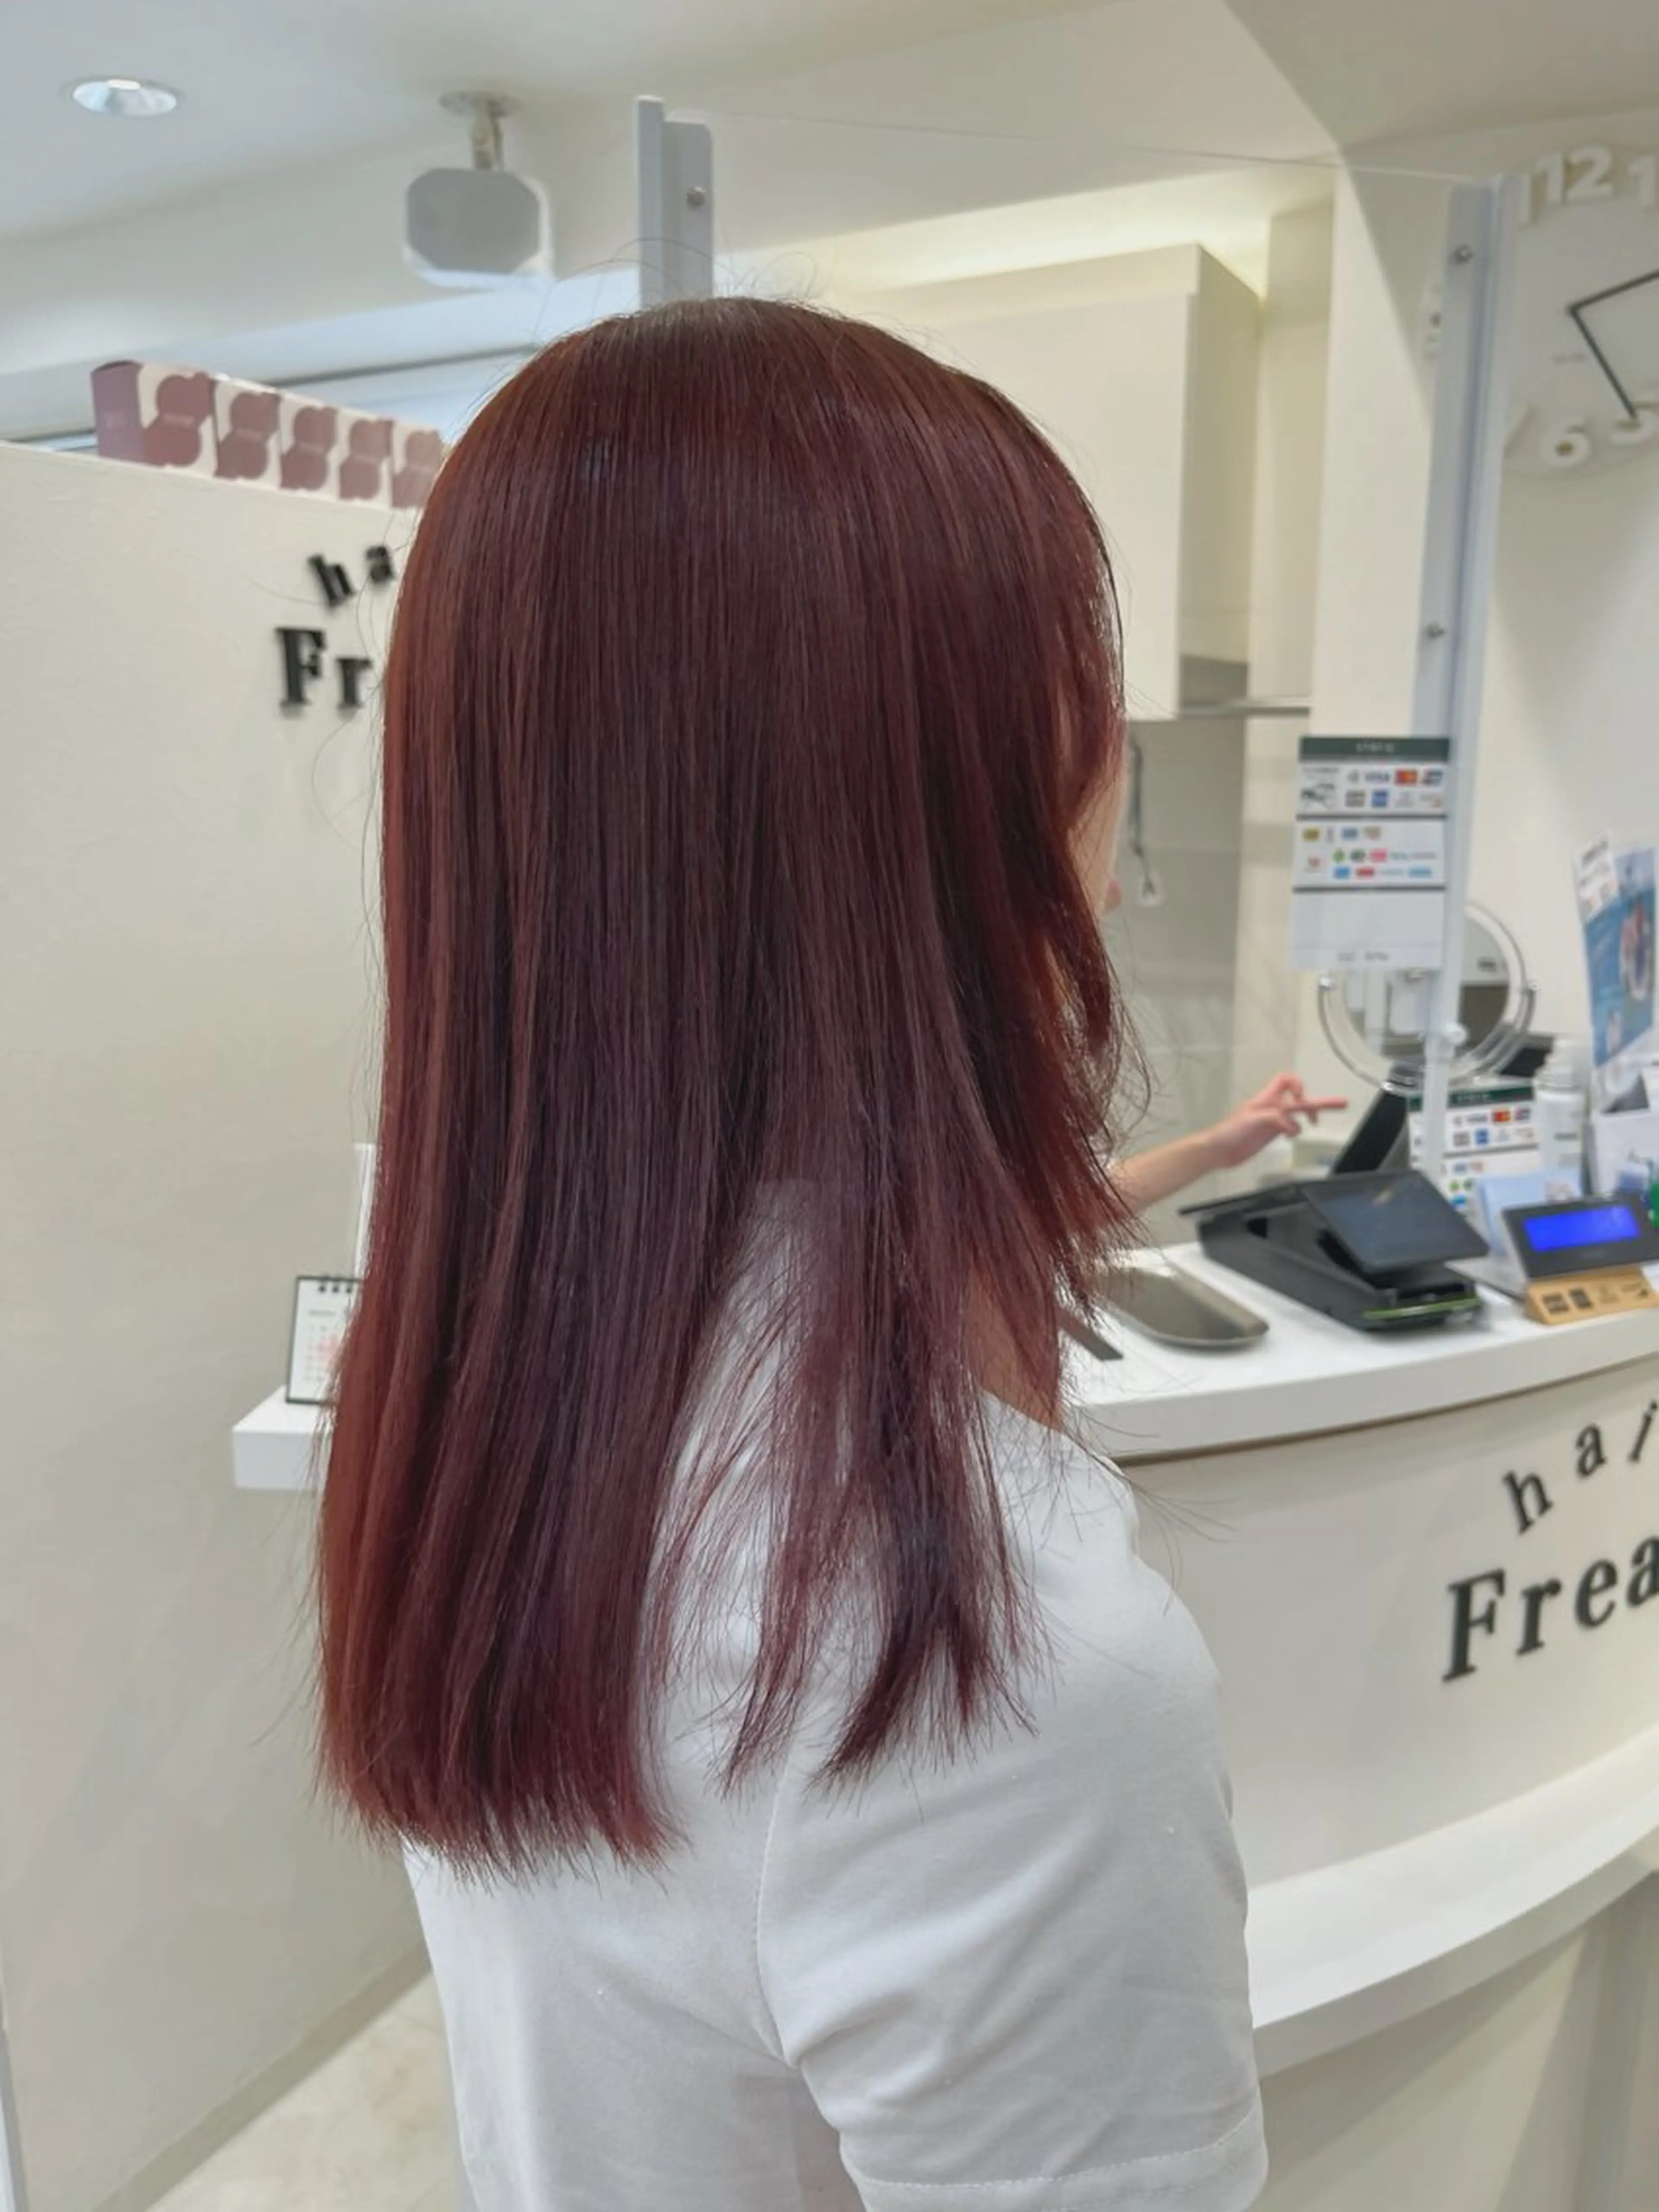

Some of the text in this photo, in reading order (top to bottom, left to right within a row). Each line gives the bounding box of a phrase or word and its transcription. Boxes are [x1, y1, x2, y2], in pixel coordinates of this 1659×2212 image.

[1534, 145, 1612, 204] 12
[1538, 416, 1592, 467] 6
[307, 545, 395, 607] ha
[274, 626, 373, 711] Fr
[1441, 1534, 1659, 1683] Frea
